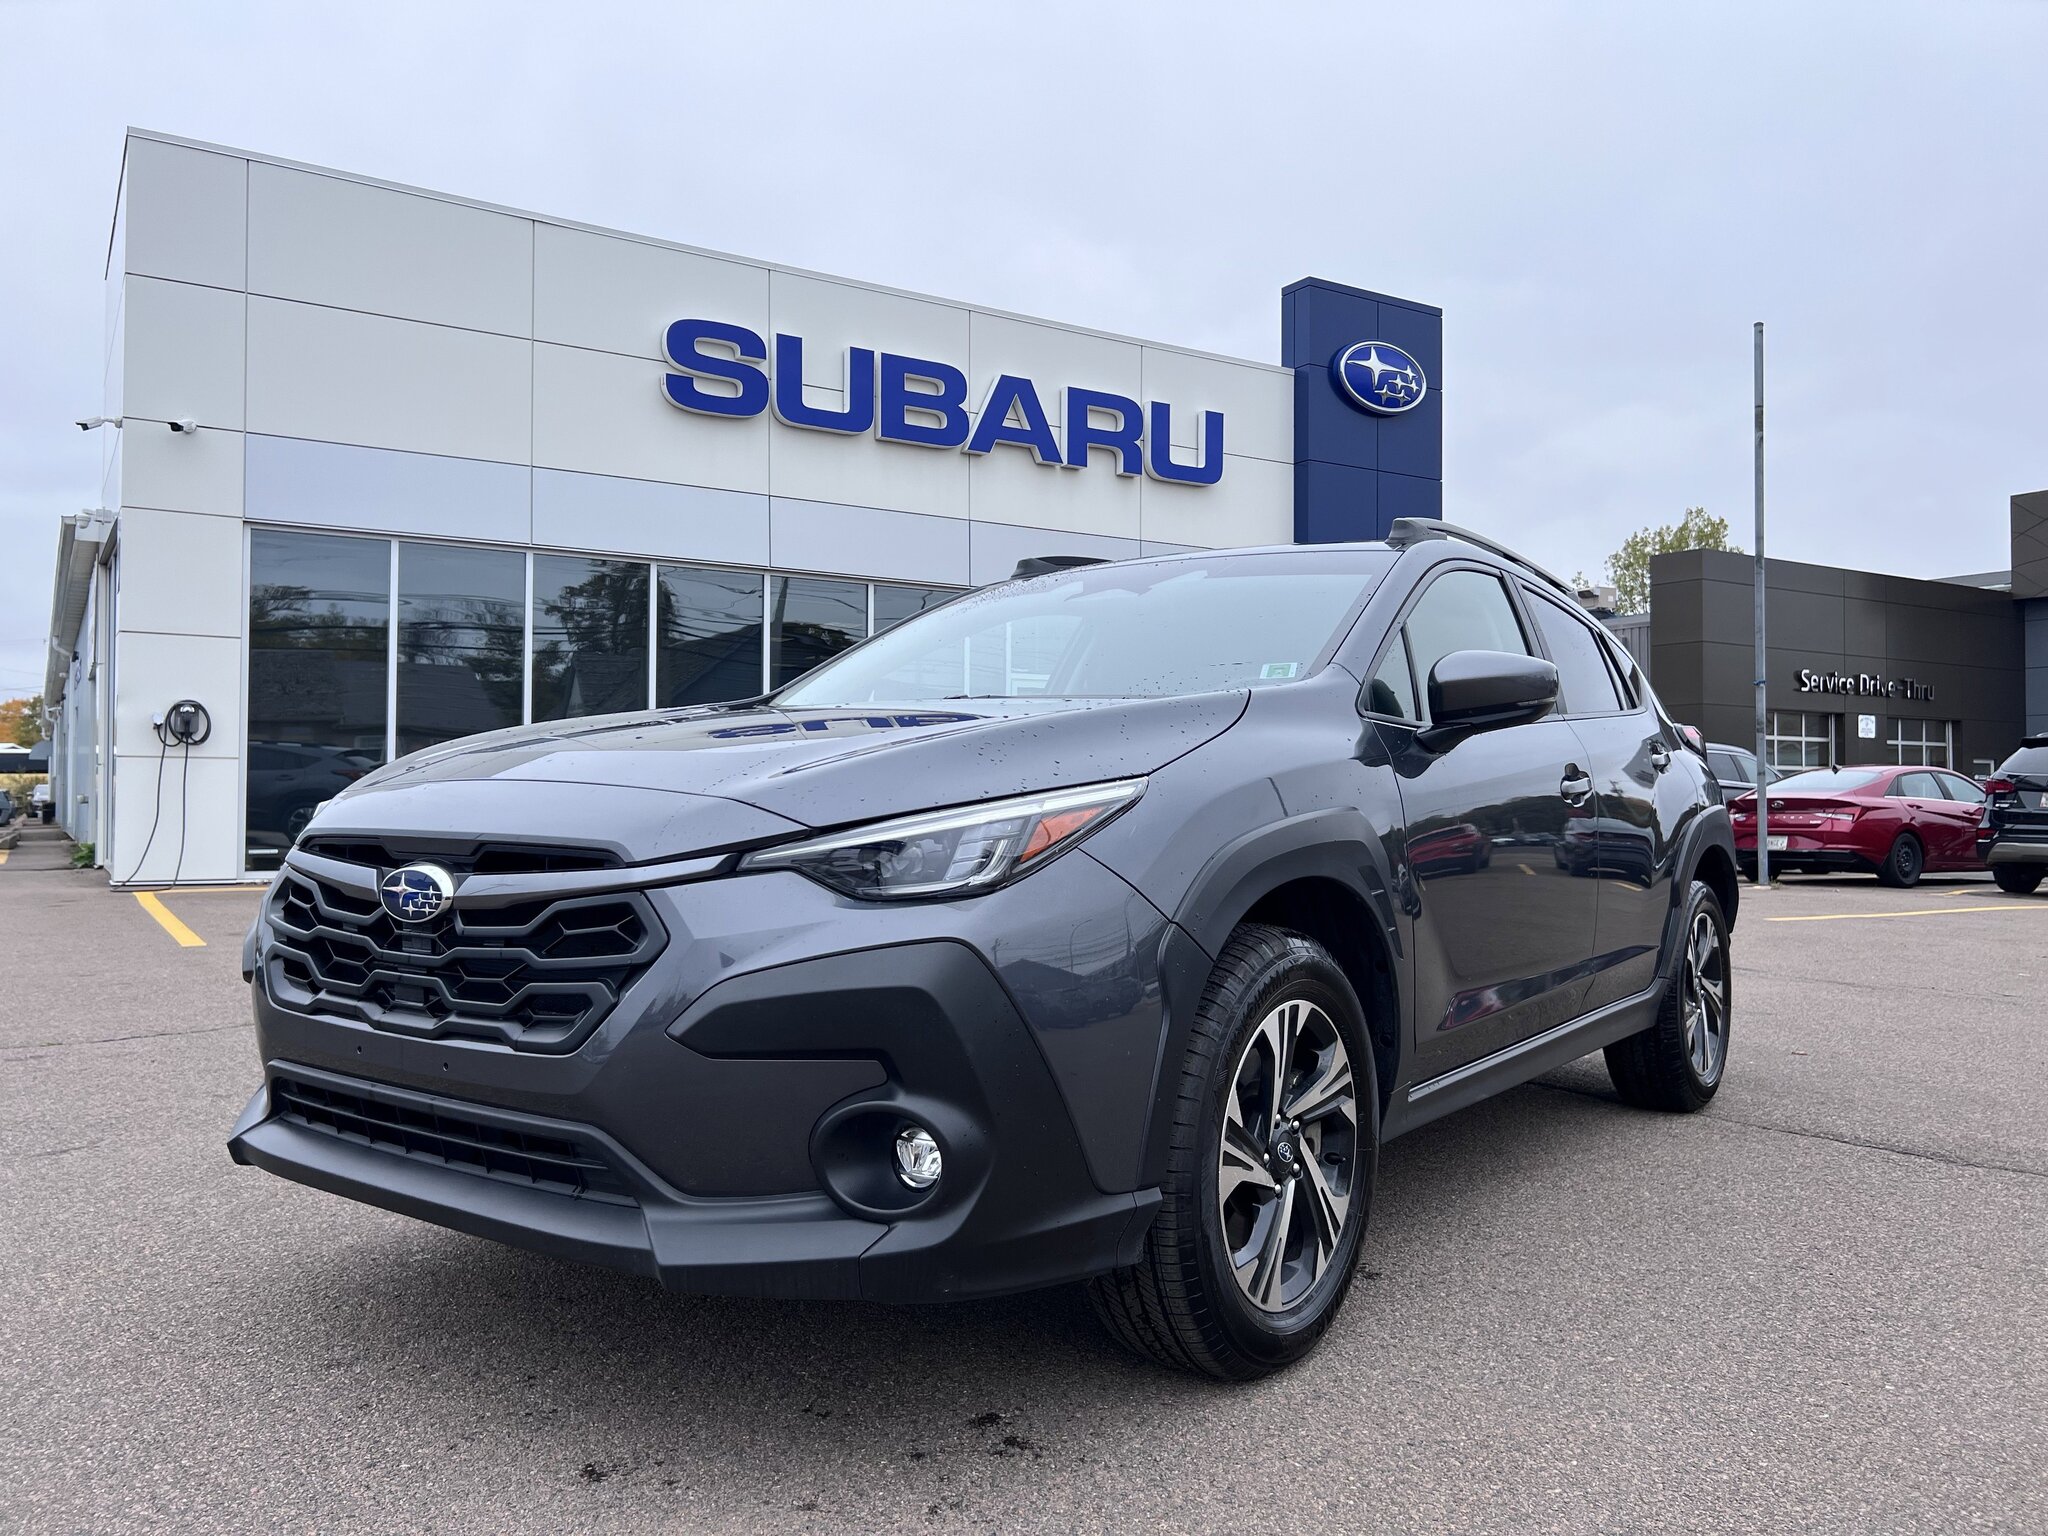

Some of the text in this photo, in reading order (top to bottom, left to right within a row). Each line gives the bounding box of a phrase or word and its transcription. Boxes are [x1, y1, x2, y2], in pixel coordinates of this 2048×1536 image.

[661, 318, 1225, 486] SUBARU
[1800, 669, 1935, 700] Service Drive-Thru
